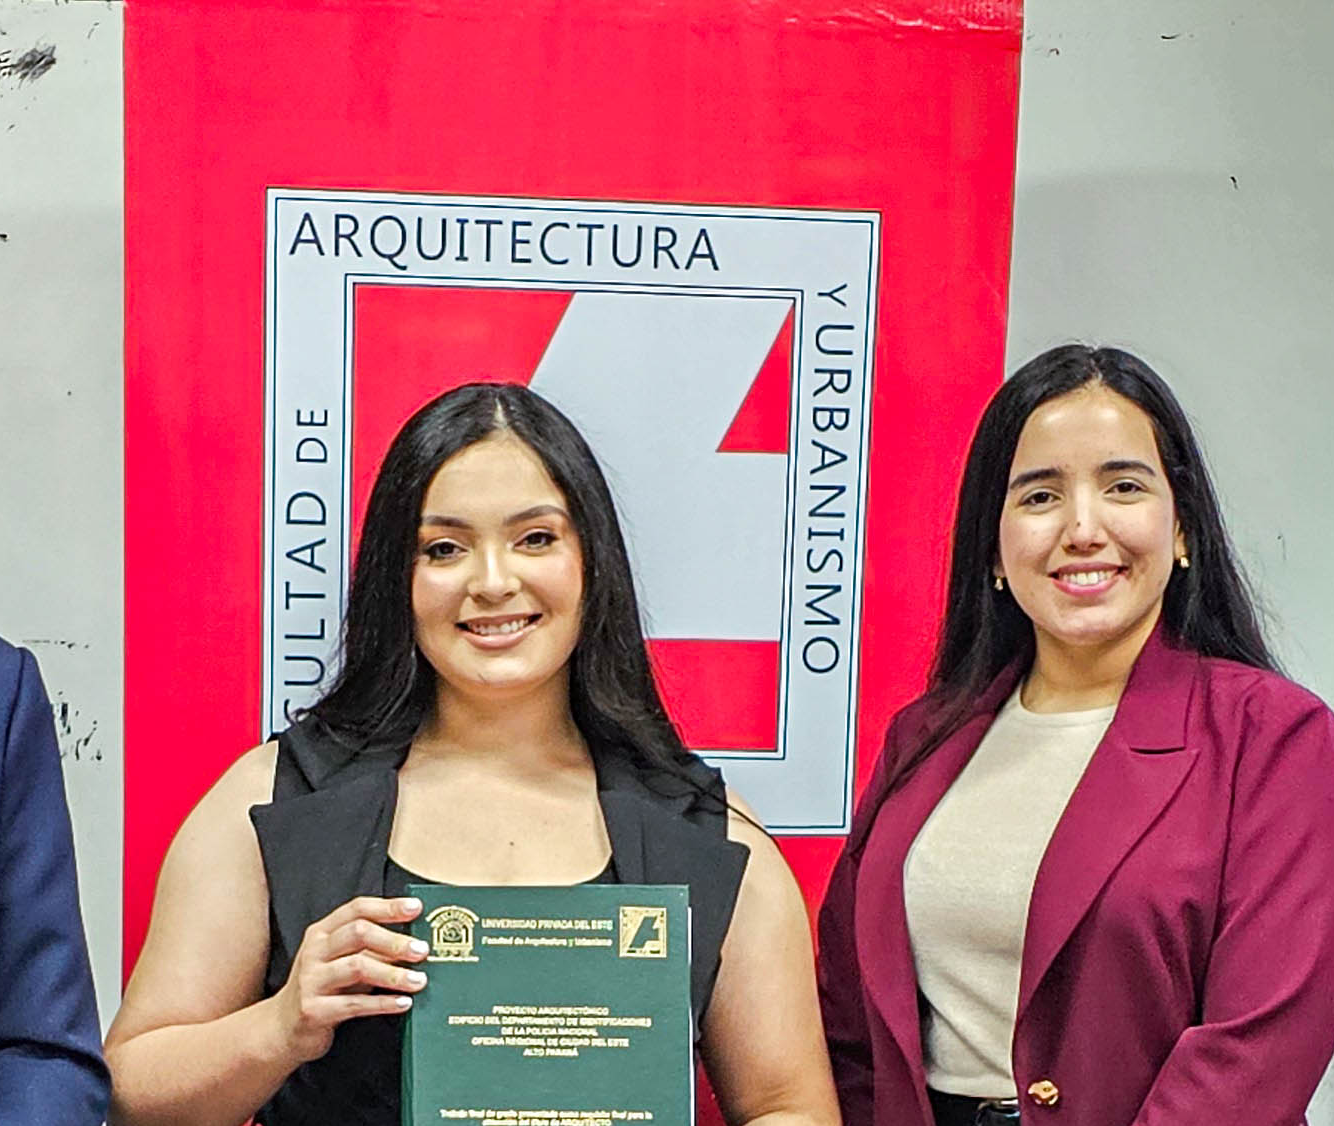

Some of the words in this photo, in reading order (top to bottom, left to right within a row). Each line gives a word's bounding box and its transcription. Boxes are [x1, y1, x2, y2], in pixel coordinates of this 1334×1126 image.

[289, 212, 720, 271] ARQUITECTURA
[816, 283, 848, 307] Y
[296, 409, 329, 463] DE
[802, 324, 855, 674] URBANISMO
[283, 491, 328, 727] ULTAD
